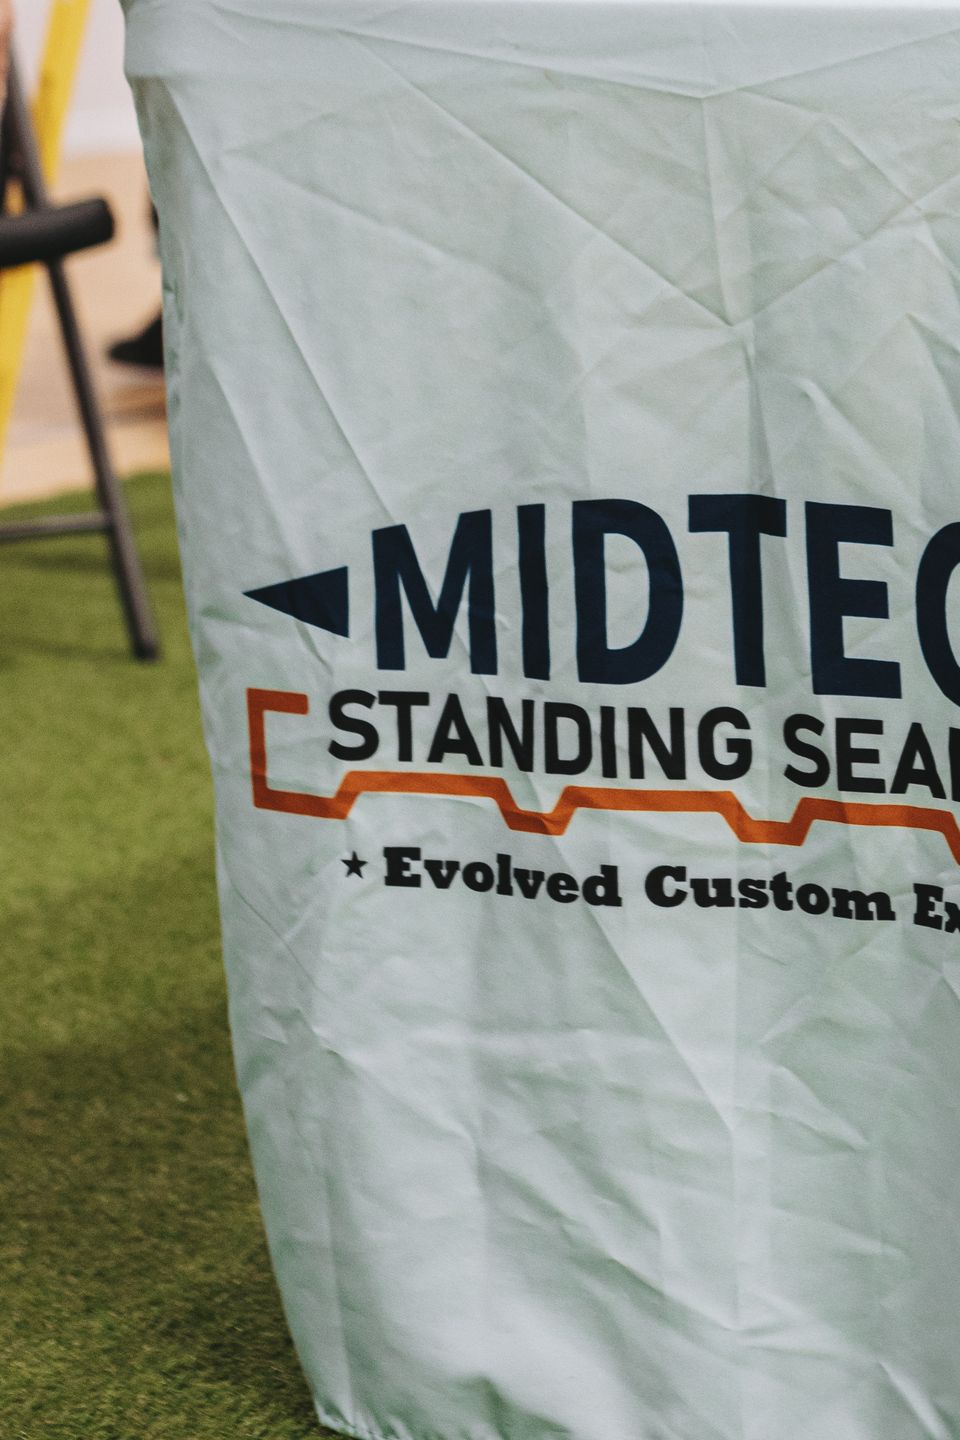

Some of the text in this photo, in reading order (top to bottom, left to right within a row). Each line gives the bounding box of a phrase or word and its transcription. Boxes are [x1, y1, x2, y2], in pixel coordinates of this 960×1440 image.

[327, 688, 753, 782] STANDING
[382, 845, 623, 908] Evolved
[644, 864, 896, 922] Custom
